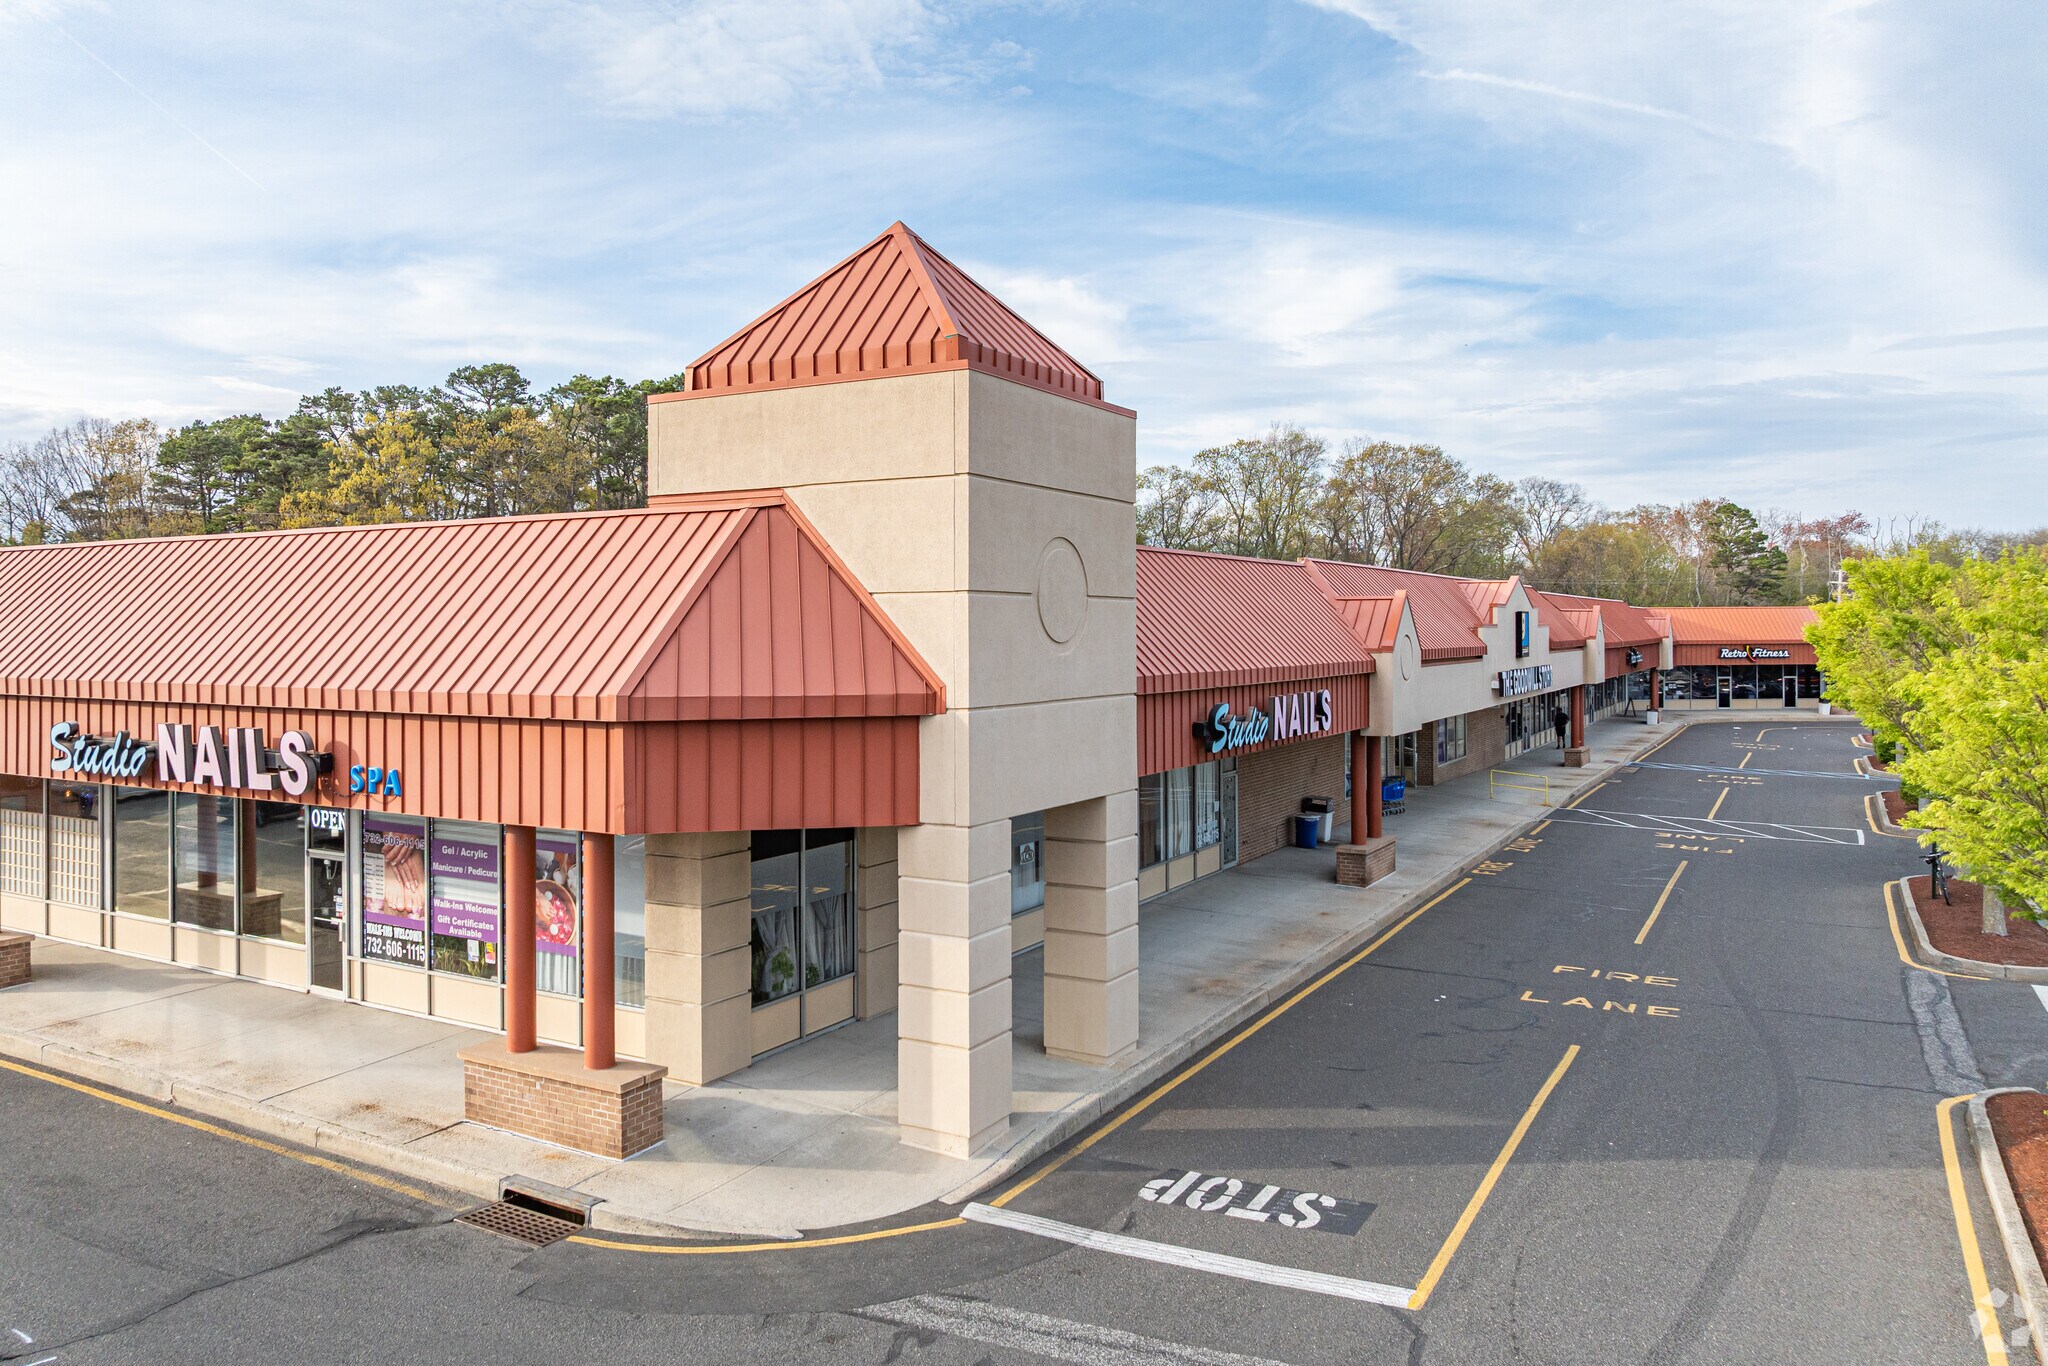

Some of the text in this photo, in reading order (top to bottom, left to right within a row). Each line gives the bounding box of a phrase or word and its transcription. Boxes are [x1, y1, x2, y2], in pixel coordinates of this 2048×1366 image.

[1720, 648, 1790, 659] Retro Fitness
[1502, 669, 1513, 697] THE
[1211, 688, 1332, 754] Studio NAILS
[50, 720, 402, 797] Studio NAILS SPA
[311, 808, 345, 831] OPEN
[364, 831, 425, 850] 732-606-1115
[442, 845, 455, 855] Gel
[461, 847, 488, 860] Acrylic
[433, 862, 464, 874] Manicure
[468, 866, 498, 878] Pedicure
[433, 898, 498, 916] Walk-Ins Welcome
[437, 915, 495, 931] Gift Certificates
[448, 926, 482, 939] Available
[366, 936, 425, 962] 732-606-1115
[1552, 964, 1680, 988] FIRE
[1520, 989, 1682, 1019] LANE
[1137, 1169, 1336, 1230] STOP
